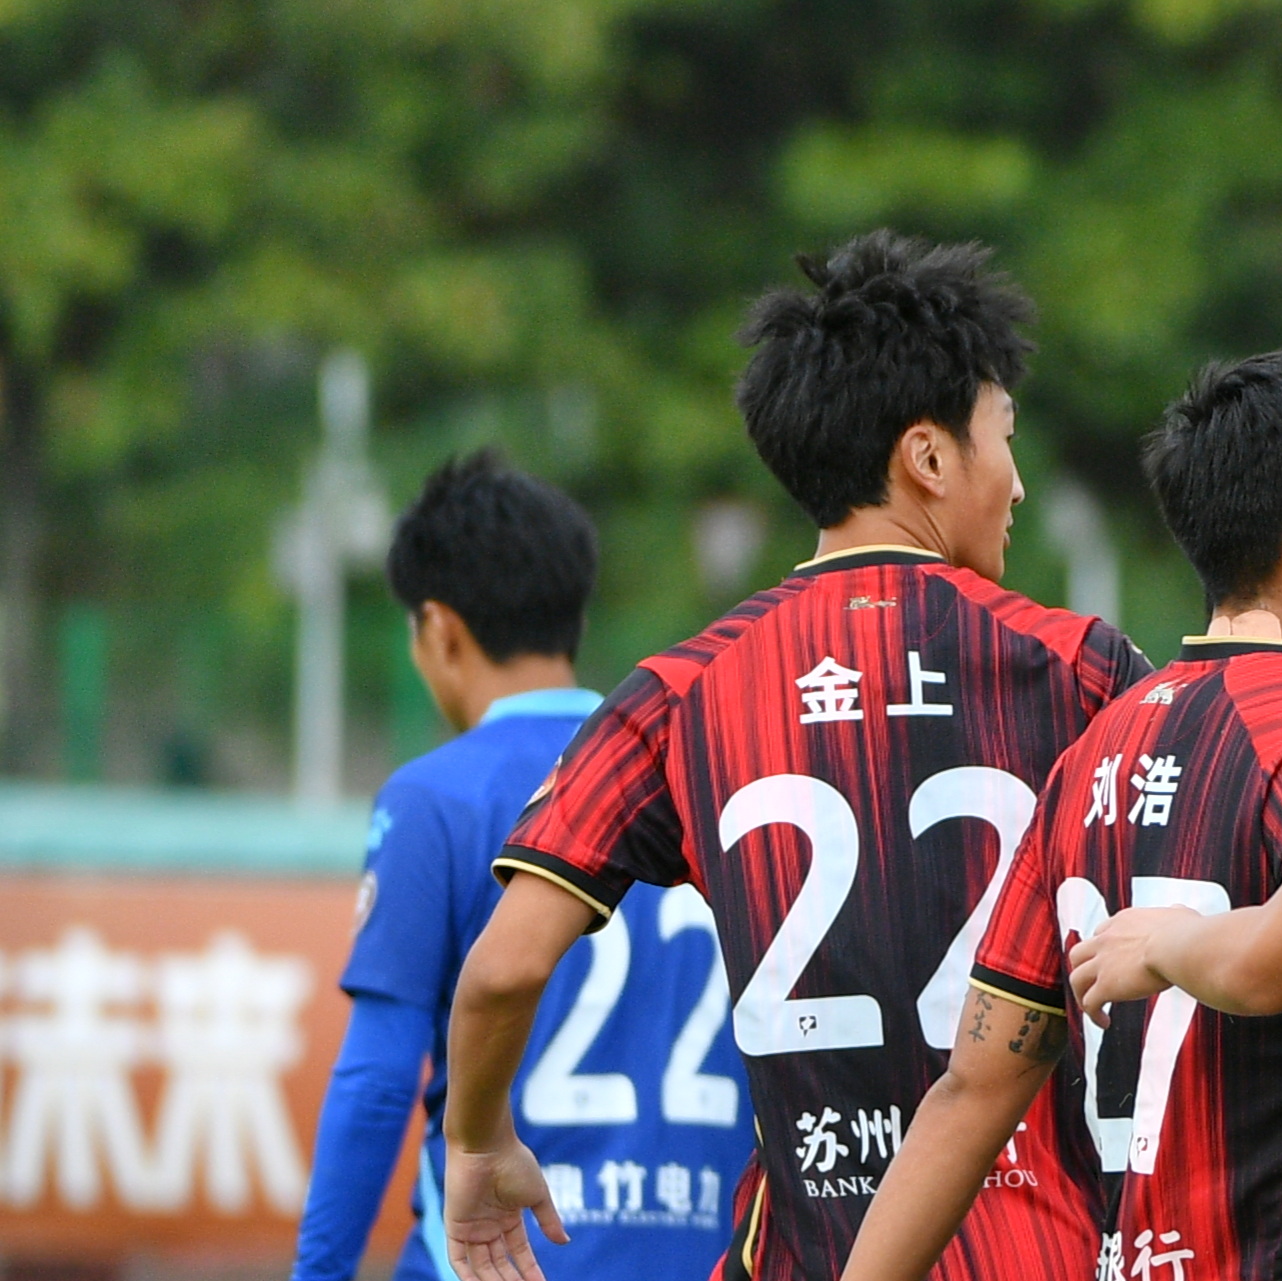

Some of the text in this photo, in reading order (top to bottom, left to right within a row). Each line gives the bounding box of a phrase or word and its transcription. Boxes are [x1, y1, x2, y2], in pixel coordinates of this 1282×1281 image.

[794, 650, 953, 724] 金上
[1083, 752, 1184, 827] 刘浩
[717, 765, 1039, 1057] 22
[522, 882, 739, 1125] 22
[803, 1175, 878, 1198] BANK
